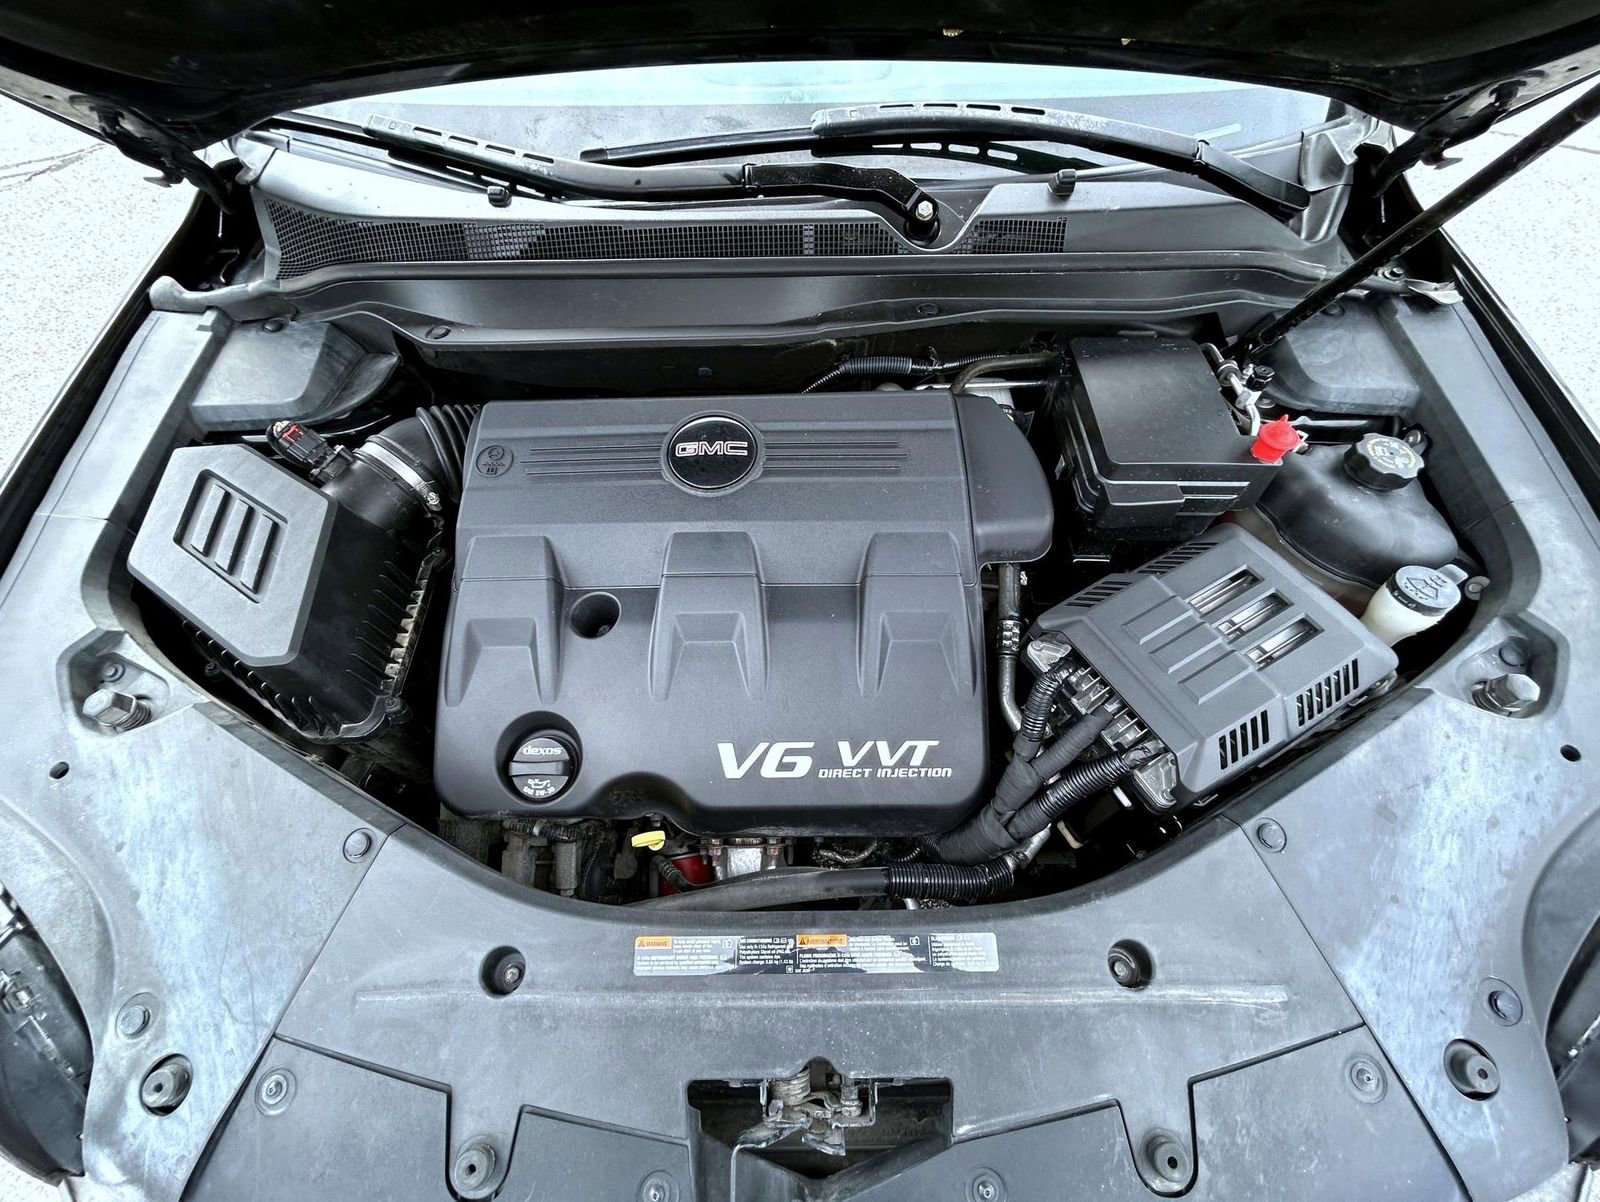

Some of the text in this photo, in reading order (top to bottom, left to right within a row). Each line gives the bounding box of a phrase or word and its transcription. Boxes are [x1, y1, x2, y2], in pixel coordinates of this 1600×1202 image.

[675, 440, 748, 457] GMC
[523, 745, 562, 755] dexos
[716, 740, 940, 779] V6 VVT
[817, 767, 953, 779] DIRECT INJECTION
[523, 786, 535, 795] SAE
